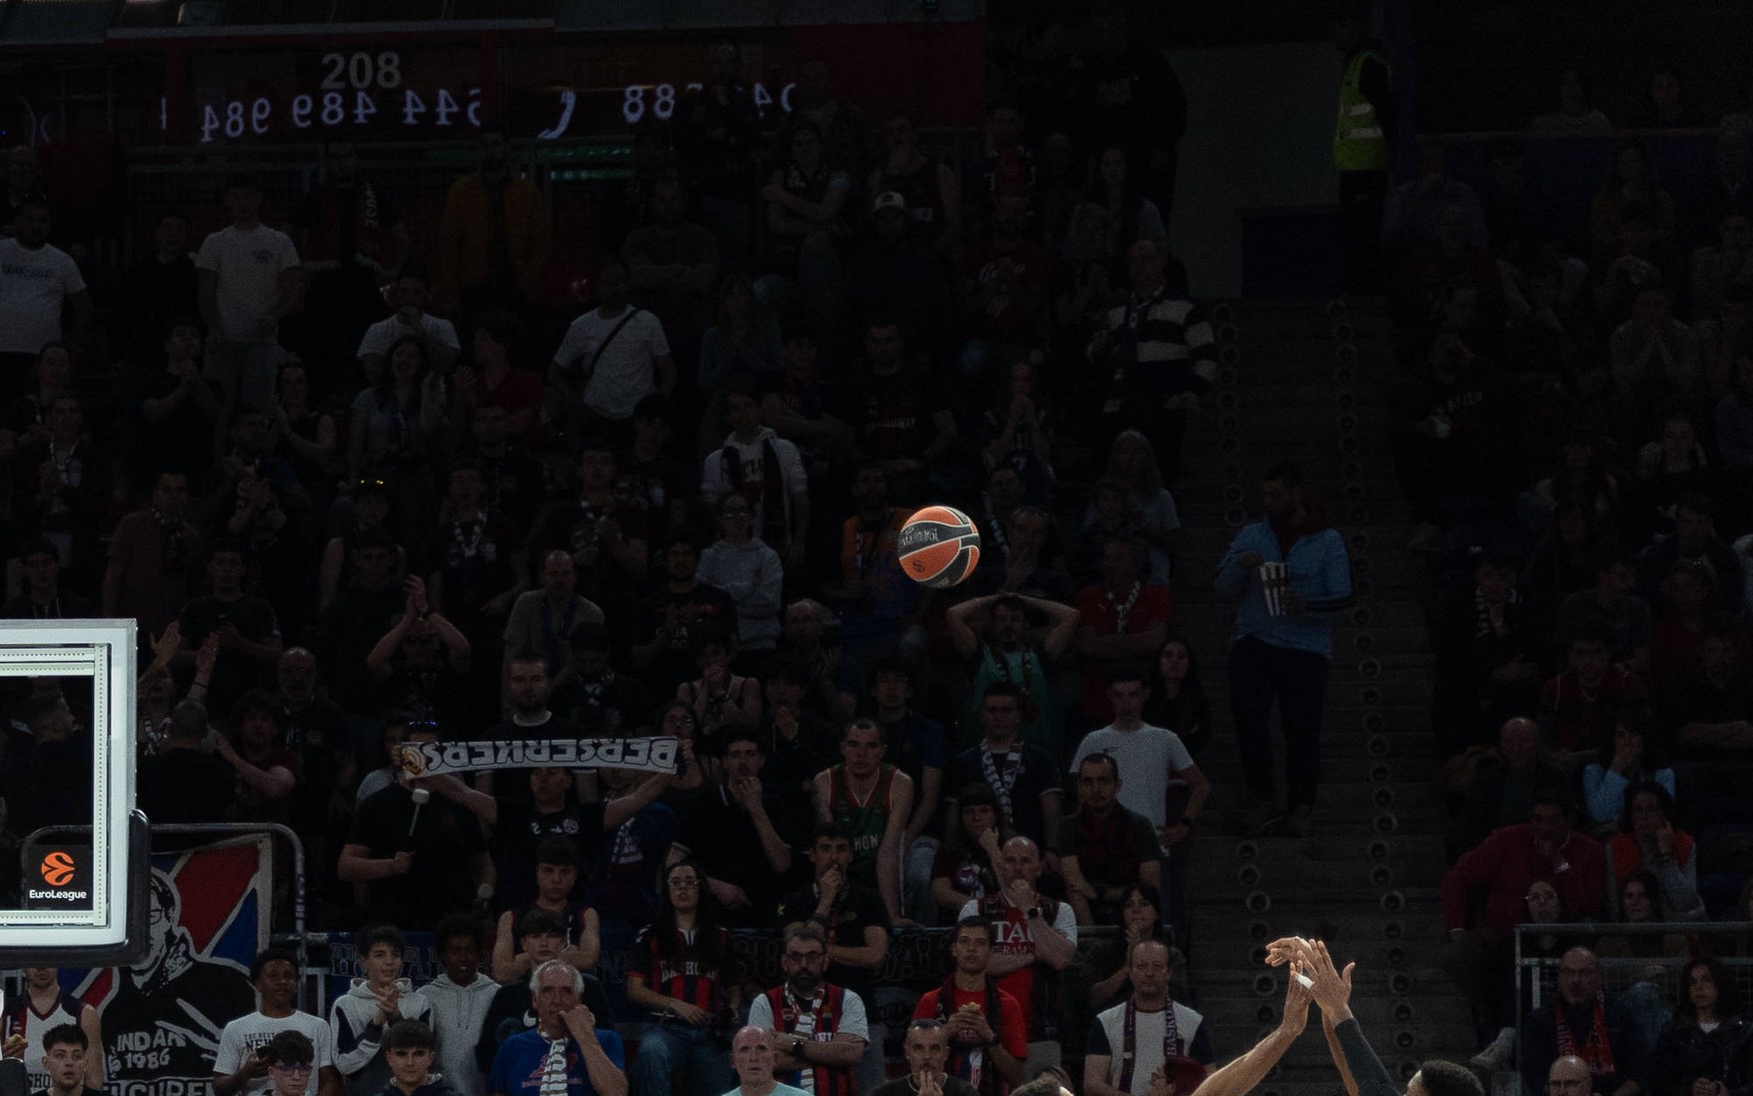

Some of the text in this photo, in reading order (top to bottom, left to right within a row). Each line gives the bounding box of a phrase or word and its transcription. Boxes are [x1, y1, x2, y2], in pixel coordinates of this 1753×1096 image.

[320, 51, 402, 90] 208
[422, 738, 679, 773] BERSERKERS
[29, 889, 87, 903] EuroLeague
[124, 1048, 172, 1070] 1986
